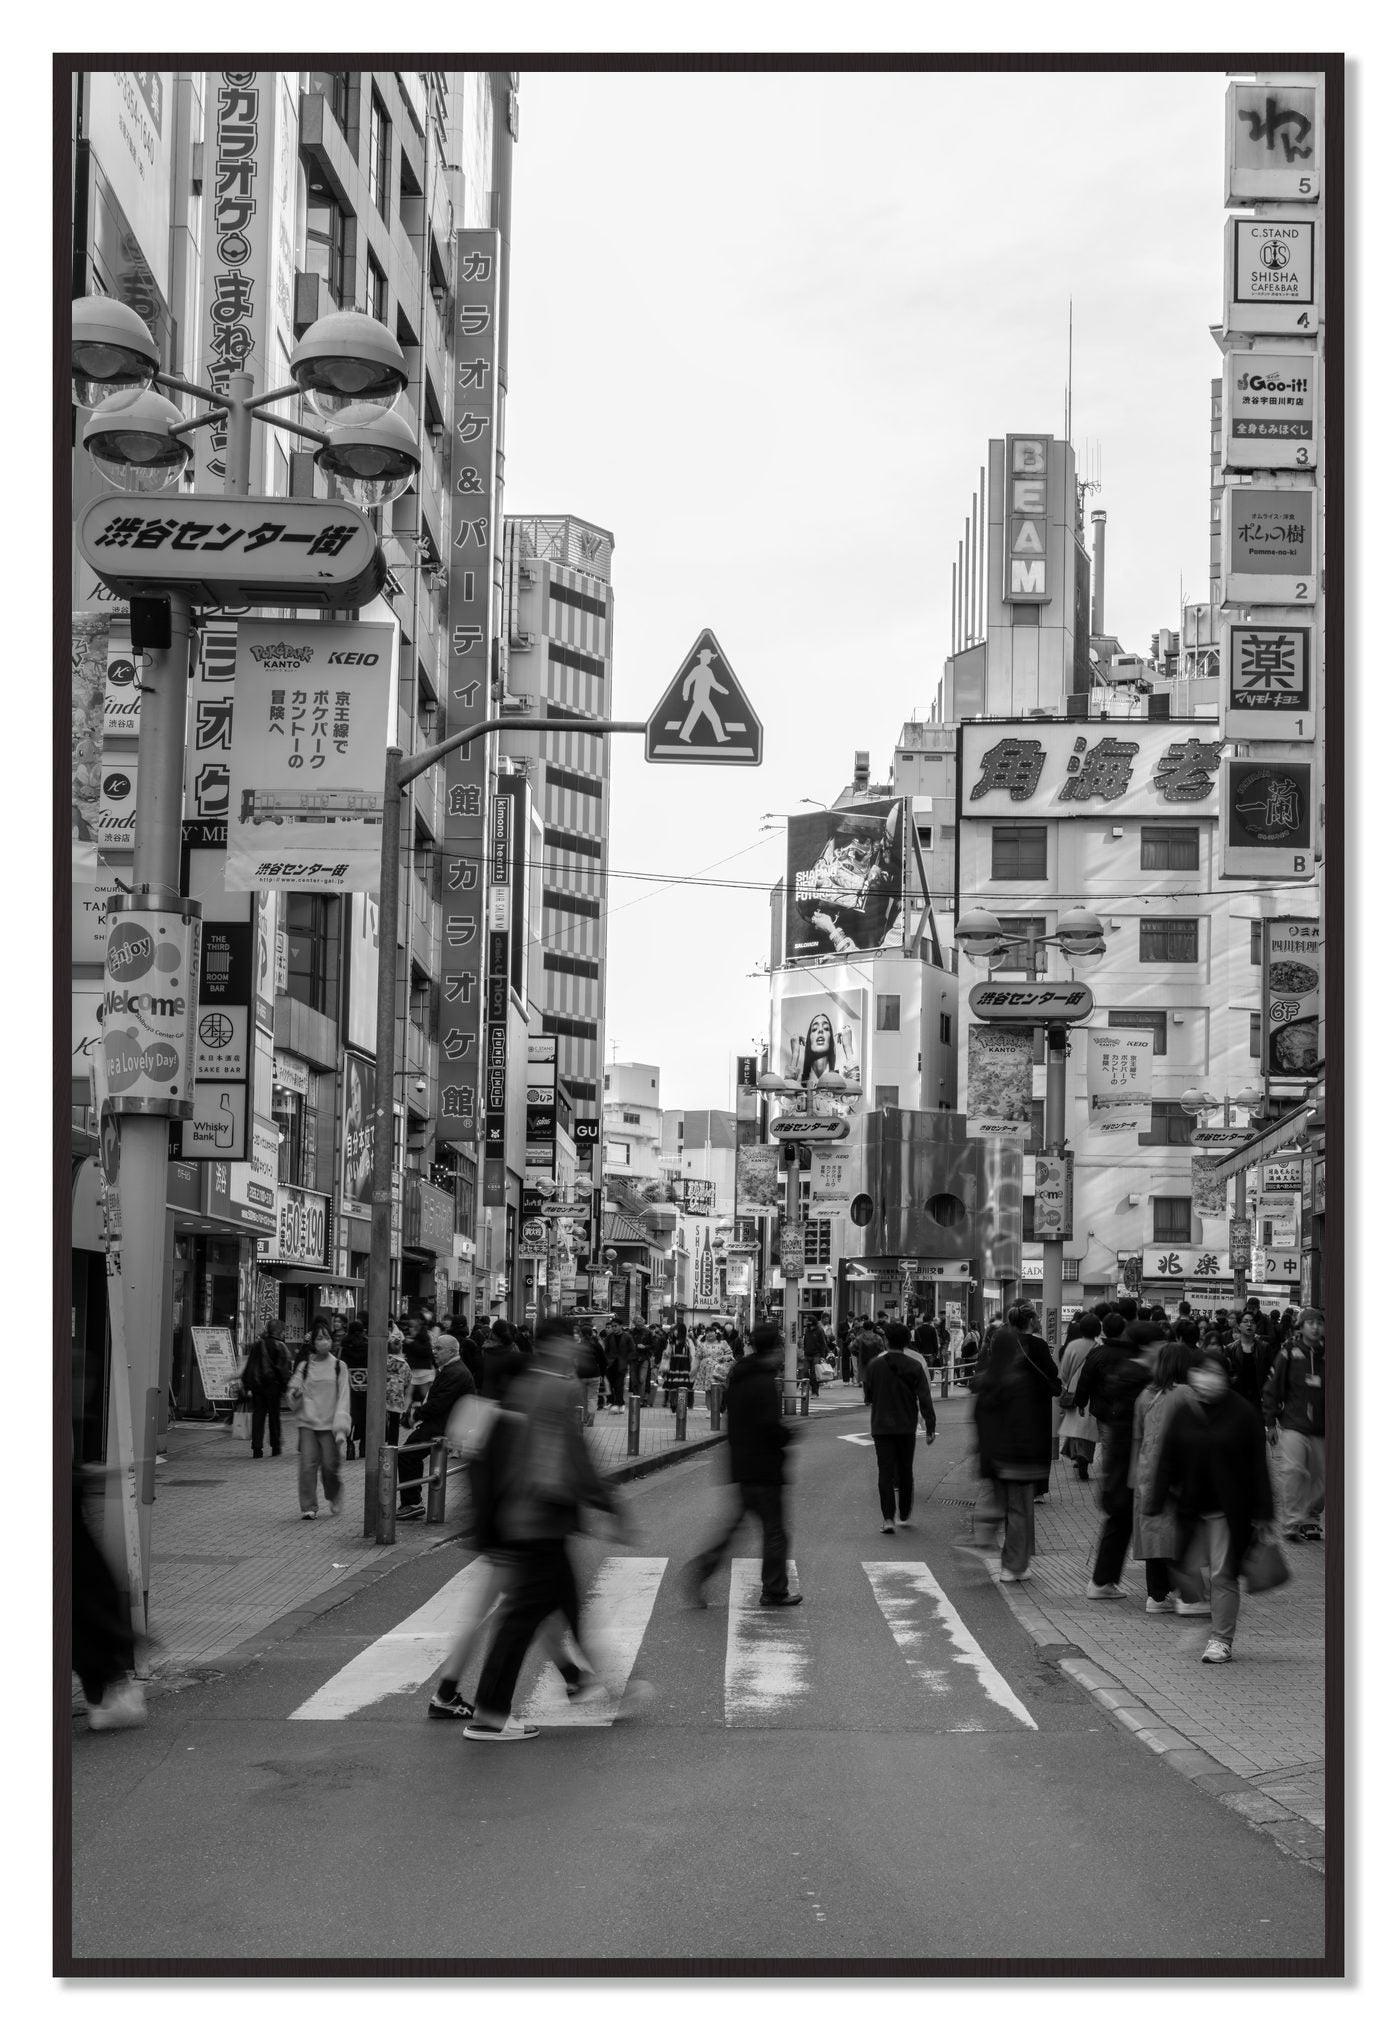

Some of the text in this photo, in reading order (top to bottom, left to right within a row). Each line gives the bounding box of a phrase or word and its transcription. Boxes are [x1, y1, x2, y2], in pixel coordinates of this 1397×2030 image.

[217, 88, 258, 234] カラオケ
[1299, 178, 1311, 194] 5
[1251, 229, 1299, 238] C.STAND
[1251, 272, 1298, 283] SHISHA
[1251, 283, 1298, 292] CAFE&BAR
[1250, 375, 1307, 392] Goo-it!
[1242, 396, 1304, 406] 渋谷宇田川町店
[1237, 423, 1308, 436] 全身もみほぐし
[1296, 447, 1308, 464] 3
[1012, 439, 1047, 594] BEAM
[94, 516, 360, 556] 渋谷センター街
[1295, 582, 1308, 599] 2
[328, 652, 379, 666] KEIO
[1241, 634, 1295, 689] 薬
[269, 690, 286, 735] 冒険へ
[109, 719, 134, 728] 渋谷店
[288, 690, 307, 769] カントーの
[310, 690, 329, 769] ポケパーク
[333, 691, 351, 754] 京王線で
[1295, 719, 1303, 735] 1
[970, 737, 1223, 801] 角海老
[1235, 778, 1300, 830] 一蘭
[496, 801, 507, 837] kimono
[104, 833, 130, 843] 渋谷店
[254, 862, 350, 876] 渋谷センター街
[1294, 856, 1306, 872] B
[207, 943, 230, 951] THIRD
[108, 937, 151, 974] Enjoy
[206, 973, 229, 981] ROOM
[103, 990, 185, 1017] Welcome
[977, 991, 1086, 1006] 渋谷センター街
[1270, 1001, 1300, 1022] 6F
[122, 1051, 154, 1073] Lovely
[156, 1053, 177, 1068] Day!
[194, 1121, 229, 1133] Whisky
[576, 1126, 598, 1137] GU
[773, 1122, 841, 1132] 渋谷センター街
[979, 1124, 1019, 1133] 渋谷センター街
[193, 1132, 214, 1141] Bank
[1158, 1252, 1220, 1276] 兆楽
[703, 1250, 712, 1295] BEER
